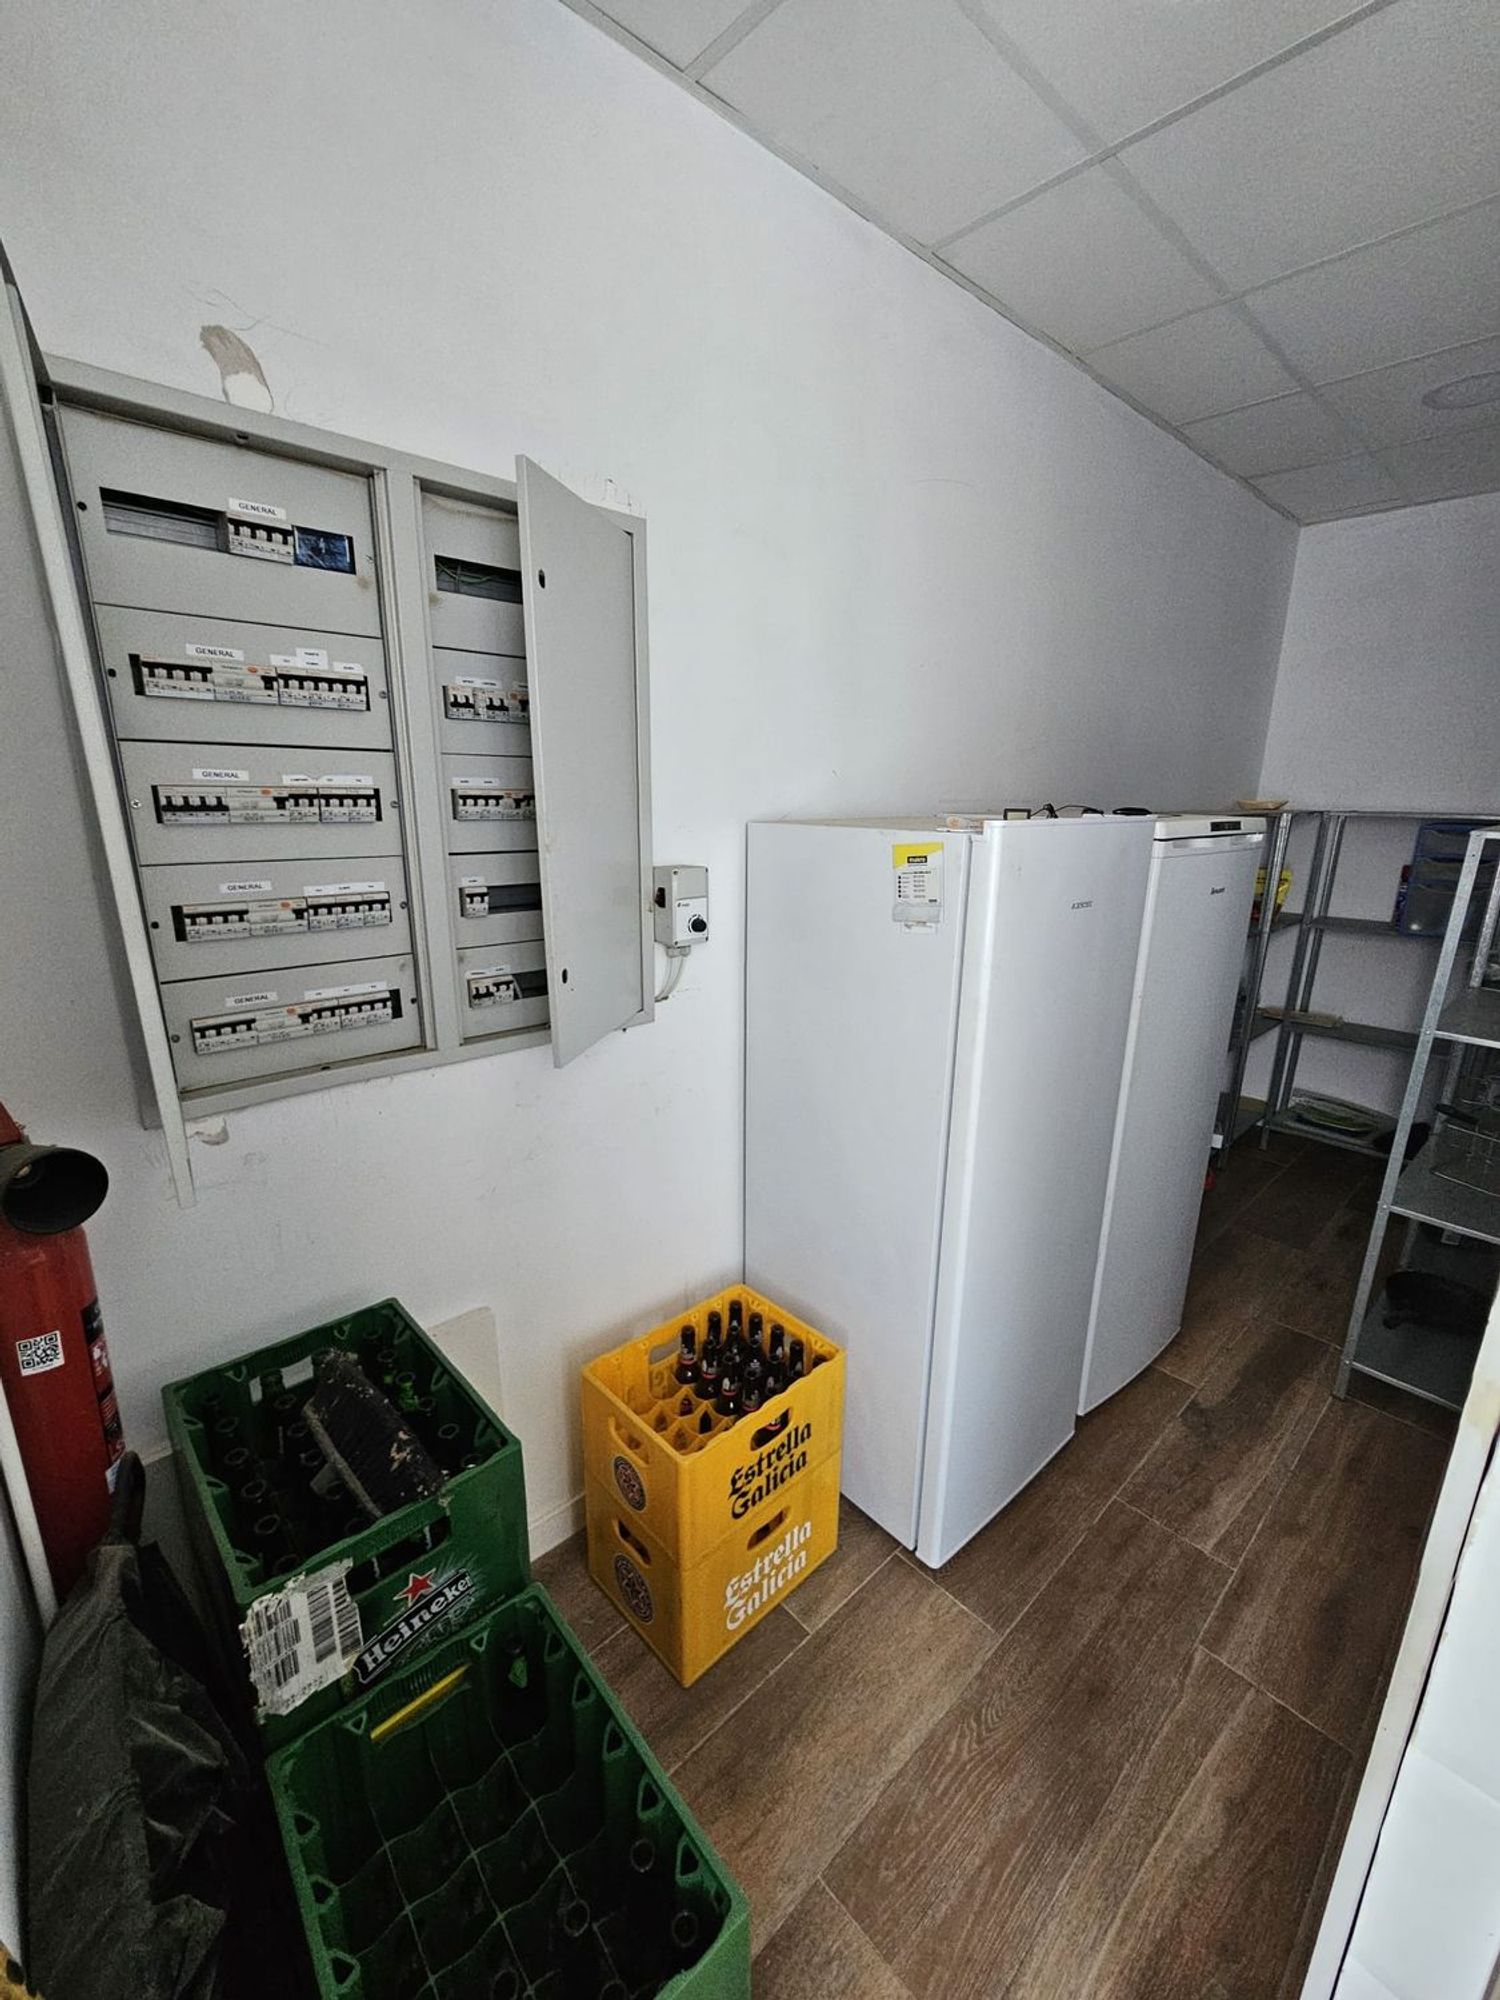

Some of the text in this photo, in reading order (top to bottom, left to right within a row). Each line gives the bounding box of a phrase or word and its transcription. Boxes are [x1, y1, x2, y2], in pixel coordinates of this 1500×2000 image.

[238, 502, 277, 516] GENERAL
[194, 647, 235, 658] GENERAL
[202, 770, 240, 779] GENERAL
[227, 883, 263, 891] GENERAL
[234, 994, 268, 1004] GENERAL
[729, 1422, 812, 1499] Estrella
[731, 1450, 808, 1520] Galicia
[724, 1521, 812, 1610] Estrella
[726, 1550, 808, 1631] Galicia
